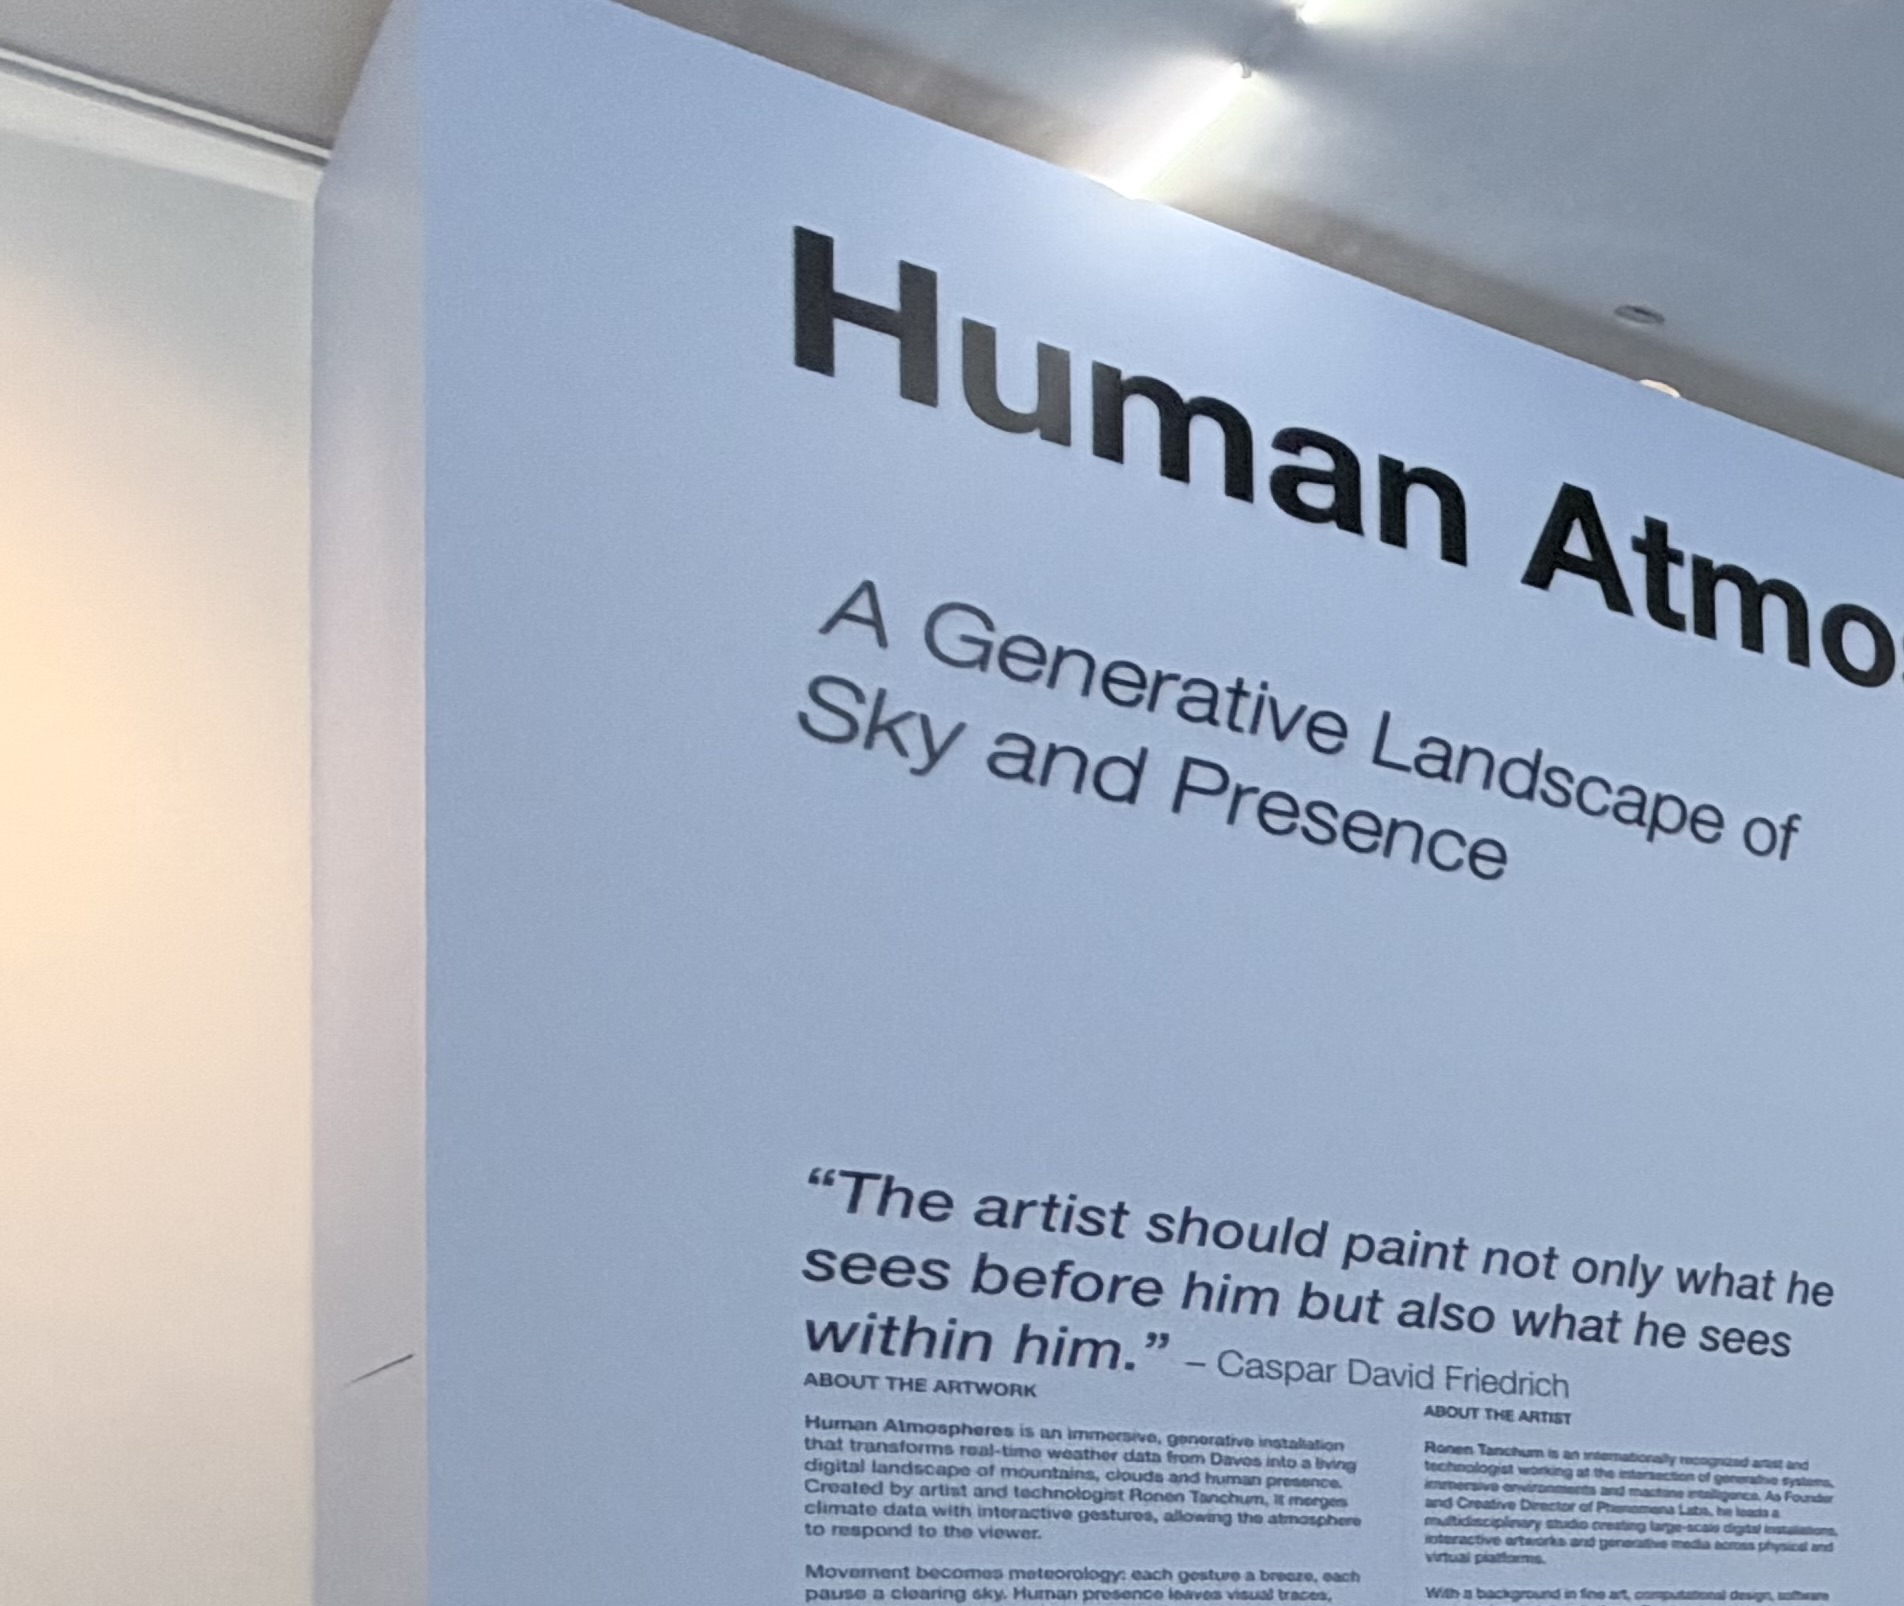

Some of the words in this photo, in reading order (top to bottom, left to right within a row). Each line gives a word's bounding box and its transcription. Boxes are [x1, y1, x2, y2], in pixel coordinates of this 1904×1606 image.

[793, 226, 1467, 567] Human
[818, 580, 888, 649] A
[925, 602, 1348, 755] Generative
[1372, 711, 1724, 844] Landscape
[1743, 814, 1801, 861] of
[798, 676, 966, 776] Sky
[987, 733, 1148, 804] and
[1172, 756, 1507, 880] Presence
[808, 1168, 953, 1222] “The
[974, 1194, 1130, 1239] artist
[1146, 1206, 1329, 1258] should
[1341, 1230, 1469, 1272] paint
[1482, 1247, 1559, 1280] not
[1573, 1254, 1663, 1298] only
[1677, 1262, 1775, 1301] what
[1787, 1271, 1833, 1307] he
[802, 1249, 950, 1290] sees
[971, 1252, 1163, 1307] before
[1181, 1271, 1279, 1316] him
[1298, 1281, 1384, 1324] but
[1397, 1293, 1495, 1333] also
[1513, 1304, 1622, 1344] what
[1634, 1311, 1686, 1348] he
[1699, 1326, 1791, 1357] sees
[806, 1312, 992, 1362] within
[1013, 1324, 1169, 1370] him.”
[804, 1373, 879, 1389] ABOUT
[886, 1376, 926, 1392] THE
[933, 1380, 1036, 1397] ARTWORK
[1218, 1350, 1336, 1386] Caspar
[1349, 1359, 1433, 1389] David
[1446, 1366, 1569, 1398] Friedrich
[804, 1414, 877, 1431] Human
[882, 1418, 1014, 1438] Atmospheres
[1019, 1423, 1034, 1438] is
[1039, 1427, 1062, 1439] an
[1067, 1426, 1161, 1445] immersive,
[1166, 1433, 1254, 1447] generative
[1258, 1435, 1345, 1452] installation
[1424, 1405, 1480, 1419] ABOUT
[1485, 1408, 1514, 1422] THE
[1518, 1410, 1571, 1425] ARTIST
[803, 1436, 842, 1451] that
[849, 1438, 954, 1455] transforms
[959, 1443, 1041, 1458] real-time
[1046, 1448, 1117, 1461] weather
[1122, 1449, 1161, 1463] data
[1166, 1450, 1205, 1464] from
[1210, 1451, 1262, 1467] Davos
[1265, 1455, 1297, 1469] into
[1301, 1459, 1311, 1469] a
[1315, 1456, 1357, 1473] living
[803, 1477, 883, 1495] Created
[889, 1480, 913, 1499] by
[919, 1483, 966, 1497] artist
[973, 1485, 1007, 1498] and
[1013, 1485, 1123, 1503] technologist
[1129, 1487, 1184, 1503] Ronen
[1189, 1489, 1269, 1507] Tanchum,
[1273, 1493, 1284, 1505] it
[1288, 1496, 1348, 1509] merges
[804, 1522, 825, 1536] to
[830, 1523, 912, 1539] respond
[917, 1524, 937, 1538] to
[942, 1524, 973, 1539] the
[977, 1525, 1042, 1540] viewer.
[805, 1563, 910, 1579] Movement
[915, 1565, 1004, 1580] becomes
[1008, 1566, 1126, 1583] meteorology:
[1130, 1568, 1173, 1581] each
[1177, 1569, 1241, 1584] gesture
[1244, 1570, 1255, 1581] a
[1259, 1569, 1318, 1583] breeze,
[1321, 1569, 1360, 1583] each
